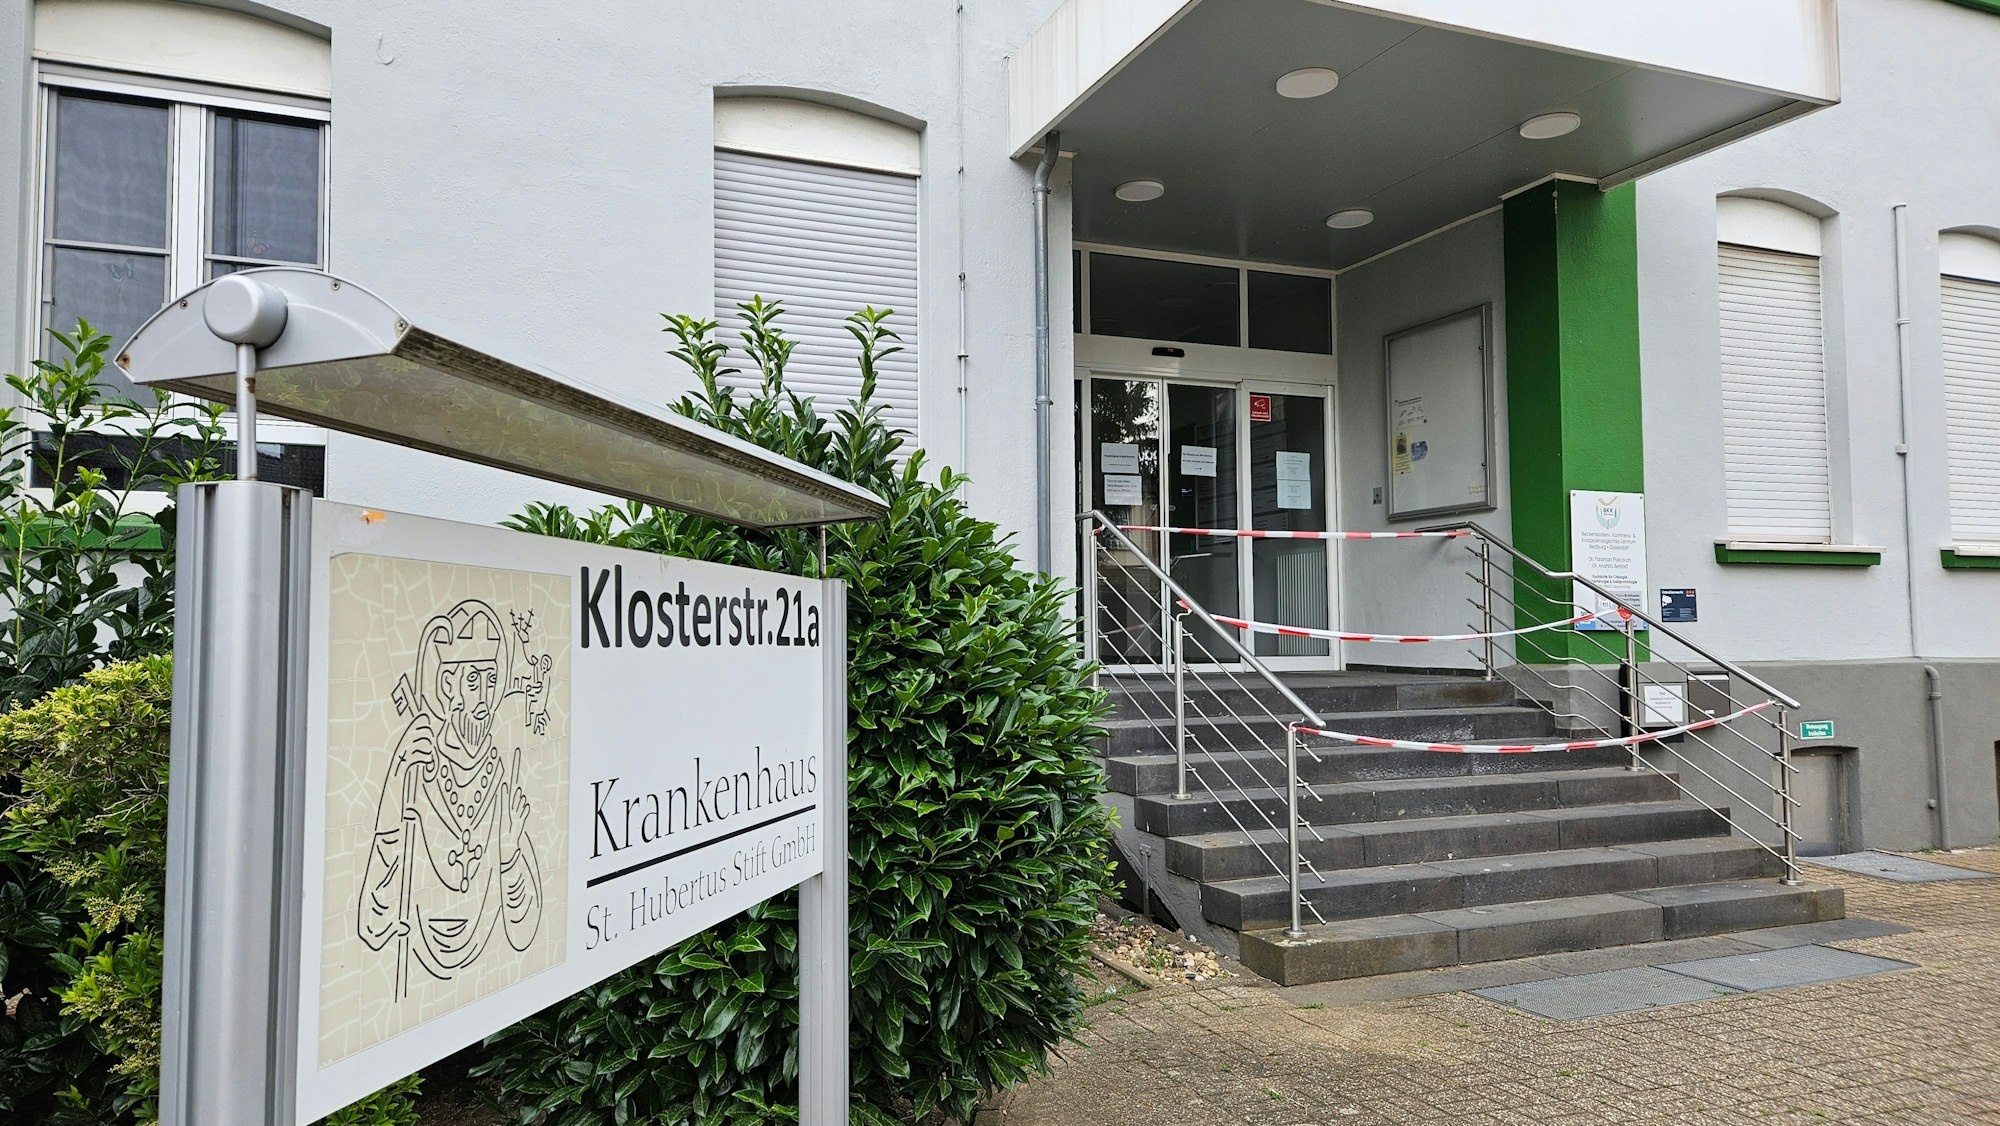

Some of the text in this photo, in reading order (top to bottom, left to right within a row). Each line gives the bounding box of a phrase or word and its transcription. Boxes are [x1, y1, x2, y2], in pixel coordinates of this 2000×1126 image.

[589, 746, 817, 860] Krankenhaus
[586, 823, 816, 951] St. Hubertus Stift GmbH
